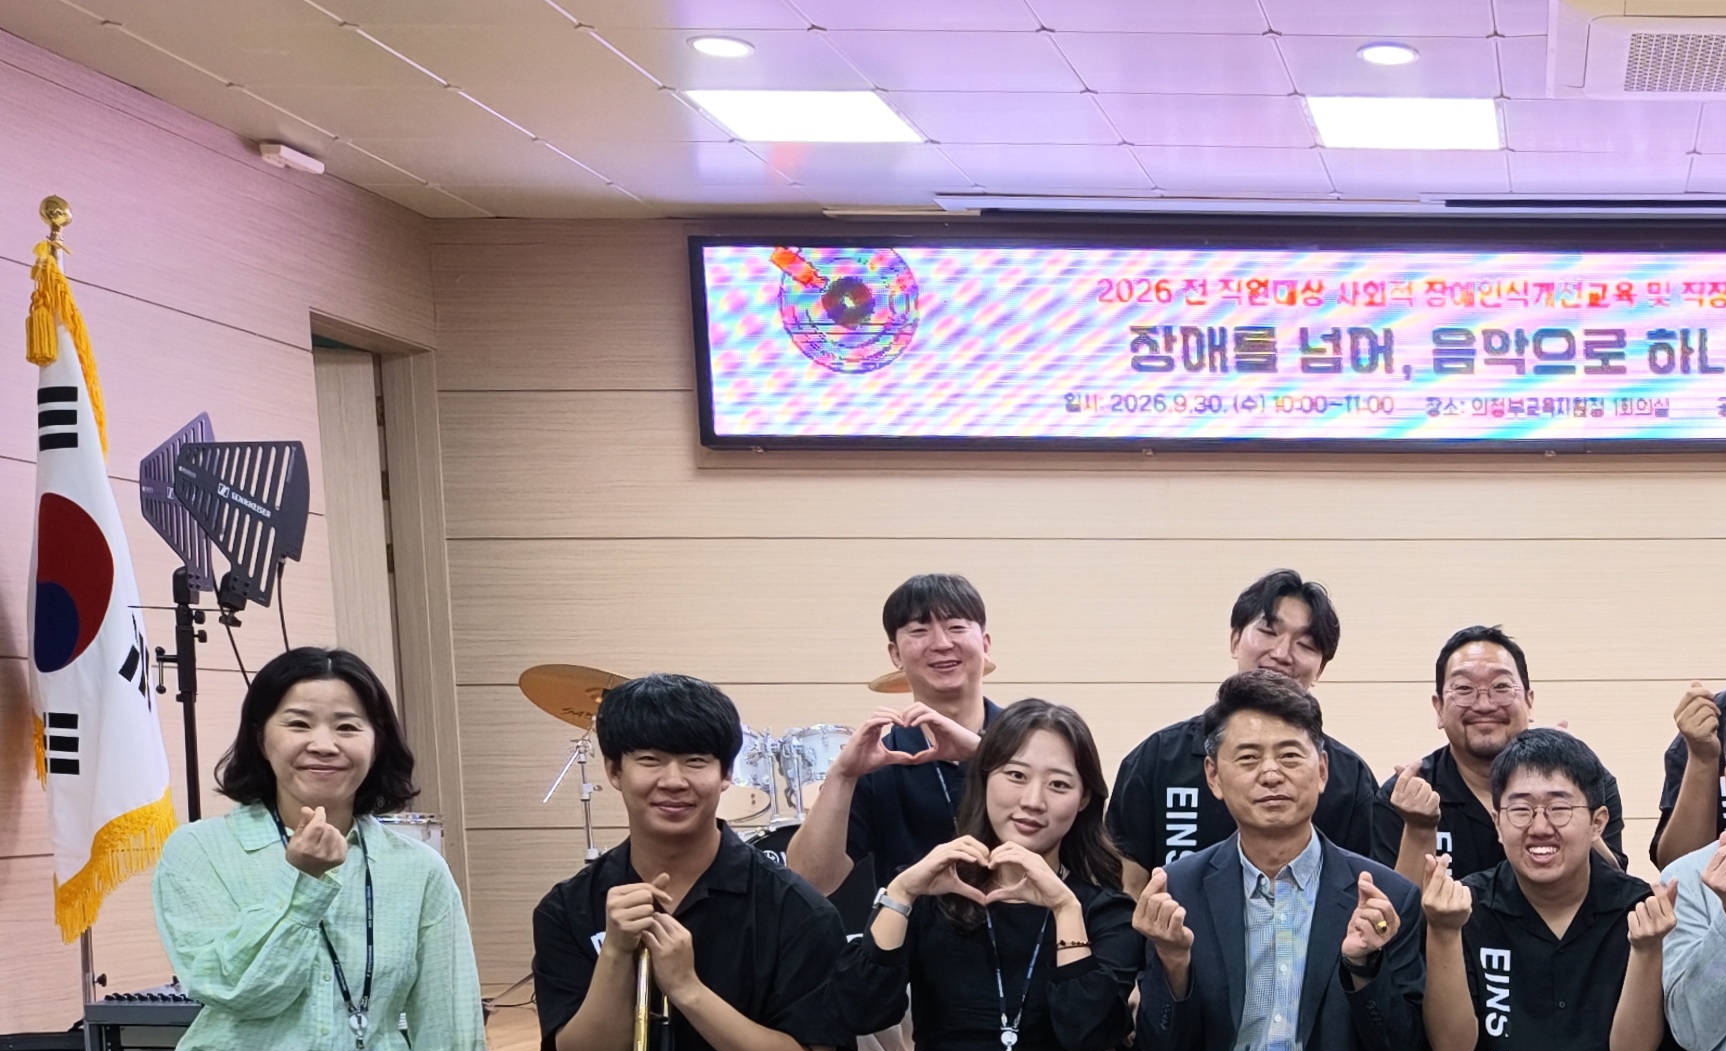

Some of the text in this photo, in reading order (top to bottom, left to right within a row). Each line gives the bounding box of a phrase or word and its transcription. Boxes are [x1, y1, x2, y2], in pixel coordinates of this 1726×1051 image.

[1097, 278, 1173, 303] 2026
[1182, 278, 1208, 306] 전
[1219, 278, 1324, 307] 직원대상
[1337, 280, 1414, 308] 사회적
[1646, 281, 1671, 308] 및
[1129, 325, 1279, 374] 장애를
[1299, 326, 1412, 381] 넘어,
[1432, 326, 1628, 376] 음악으로
[1479, 947, 1511, 1038] EINS
